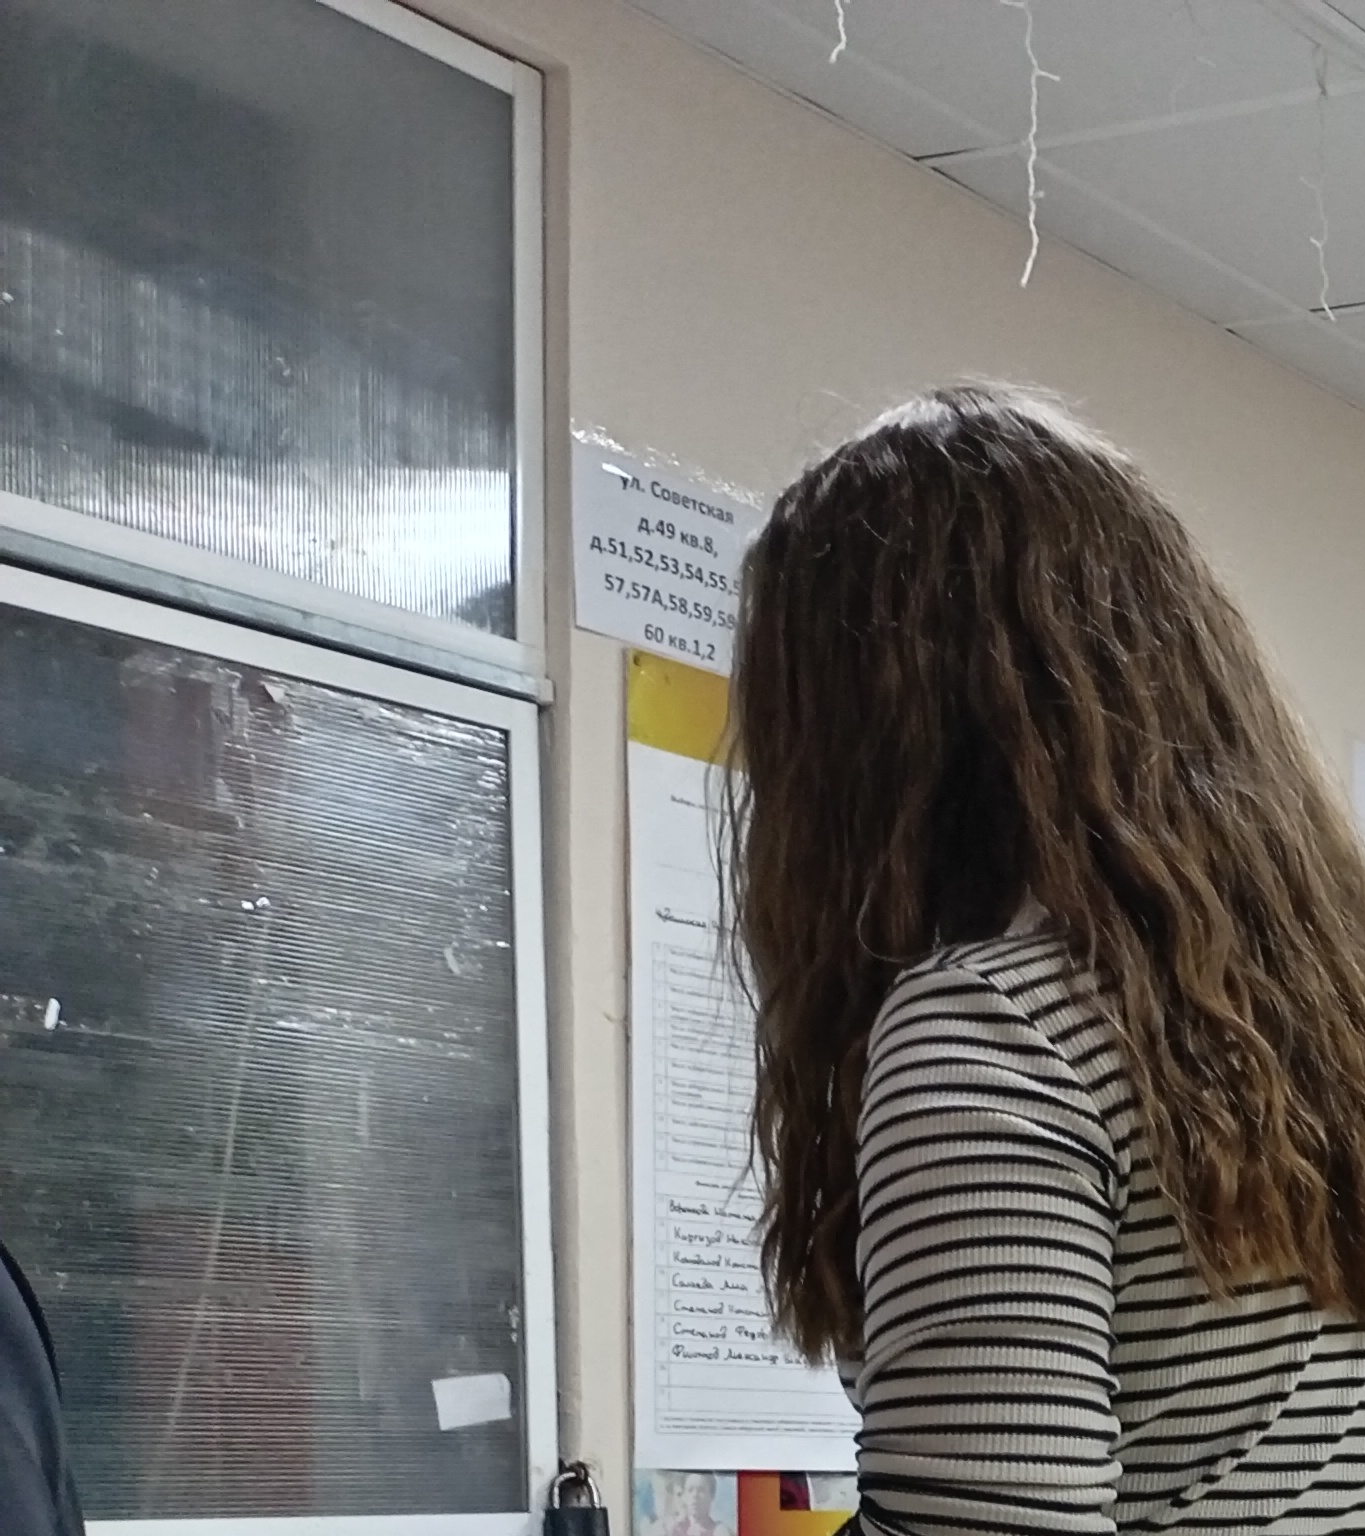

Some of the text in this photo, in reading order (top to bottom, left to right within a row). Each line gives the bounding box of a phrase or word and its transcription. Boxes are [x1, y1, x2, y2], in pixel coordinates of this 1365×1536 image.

[651, 481, 734, 524] Советская
[638, 517, 718, 558] д.49 кв.8,
[644, 623, 715, 661] 60 кв.1,2
